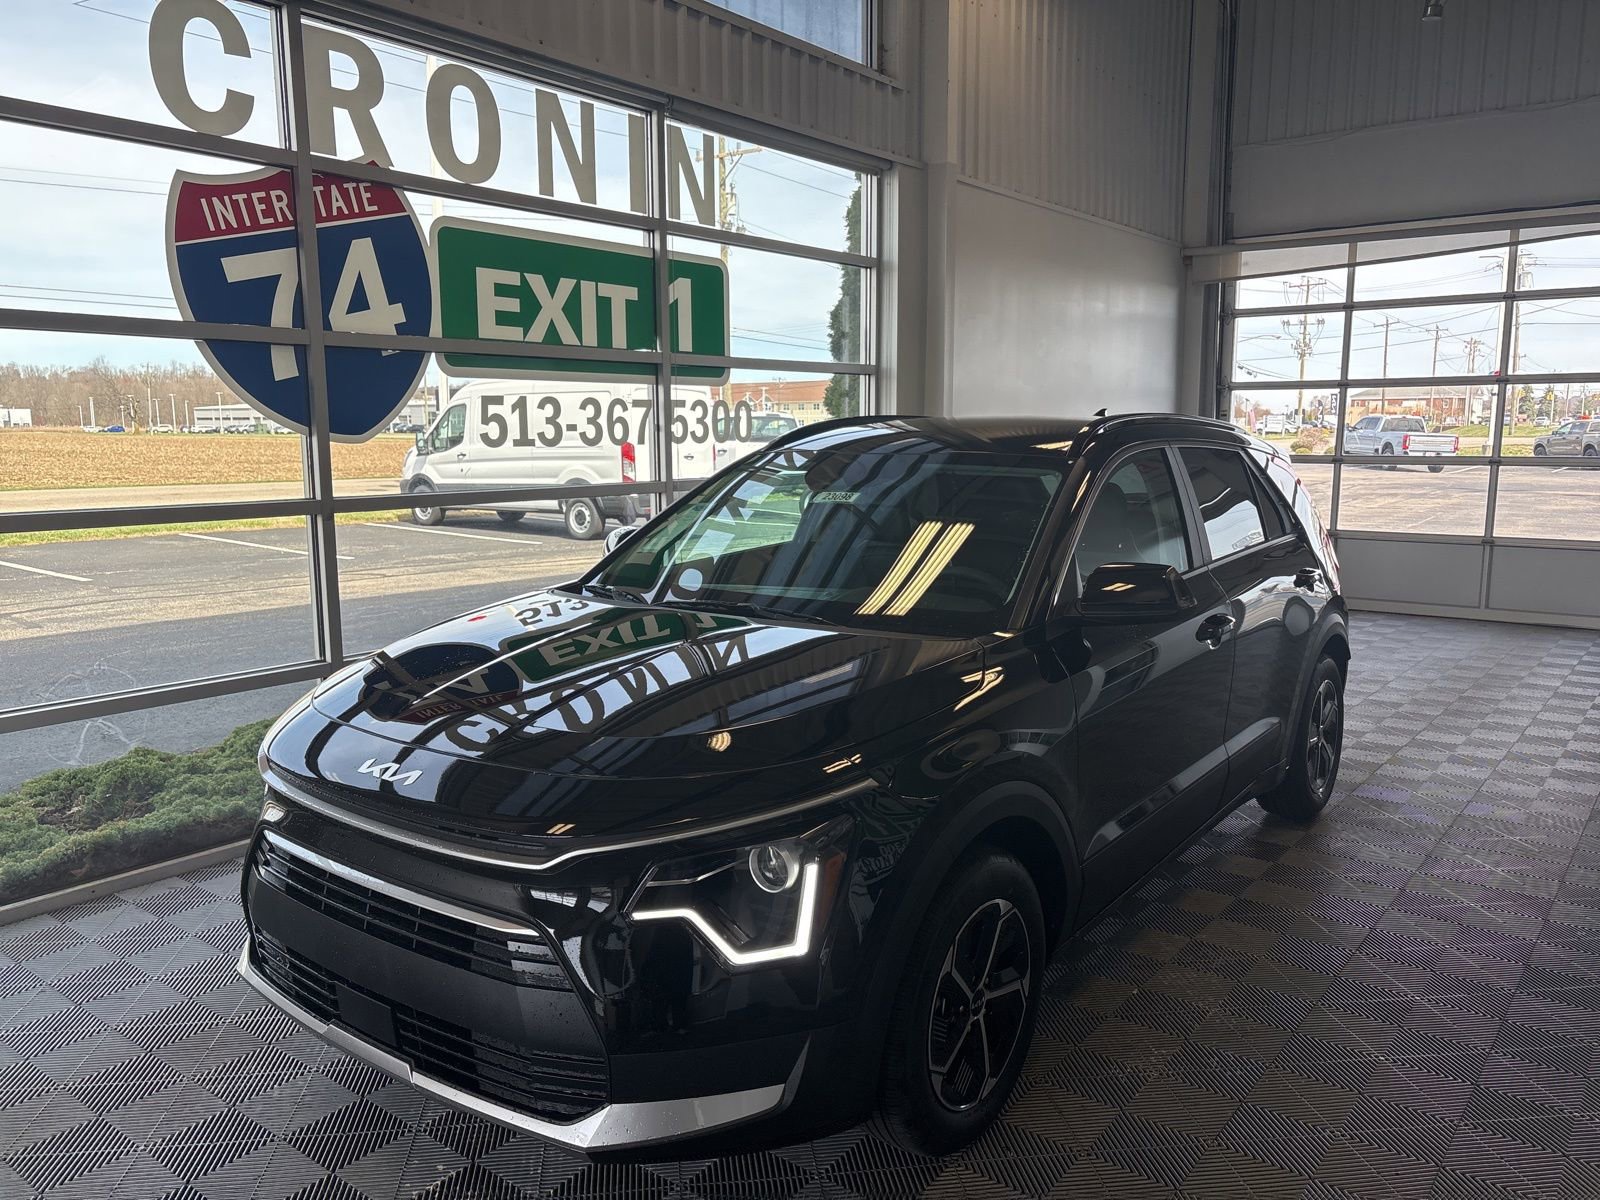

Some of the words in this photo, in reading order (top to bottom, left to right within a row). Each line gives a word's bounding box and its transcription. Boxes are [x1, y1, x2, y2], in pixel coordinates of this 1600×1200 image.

[149, 0, 716, 227] CRONIN
[200, 181, 378, 232] INTERTATE
[220, 237, 407, 382] 74
[475, 267, 638, 350] EXIT
[668, 278, 693, 352] 1
[357, 758, 423, 786] KIA
